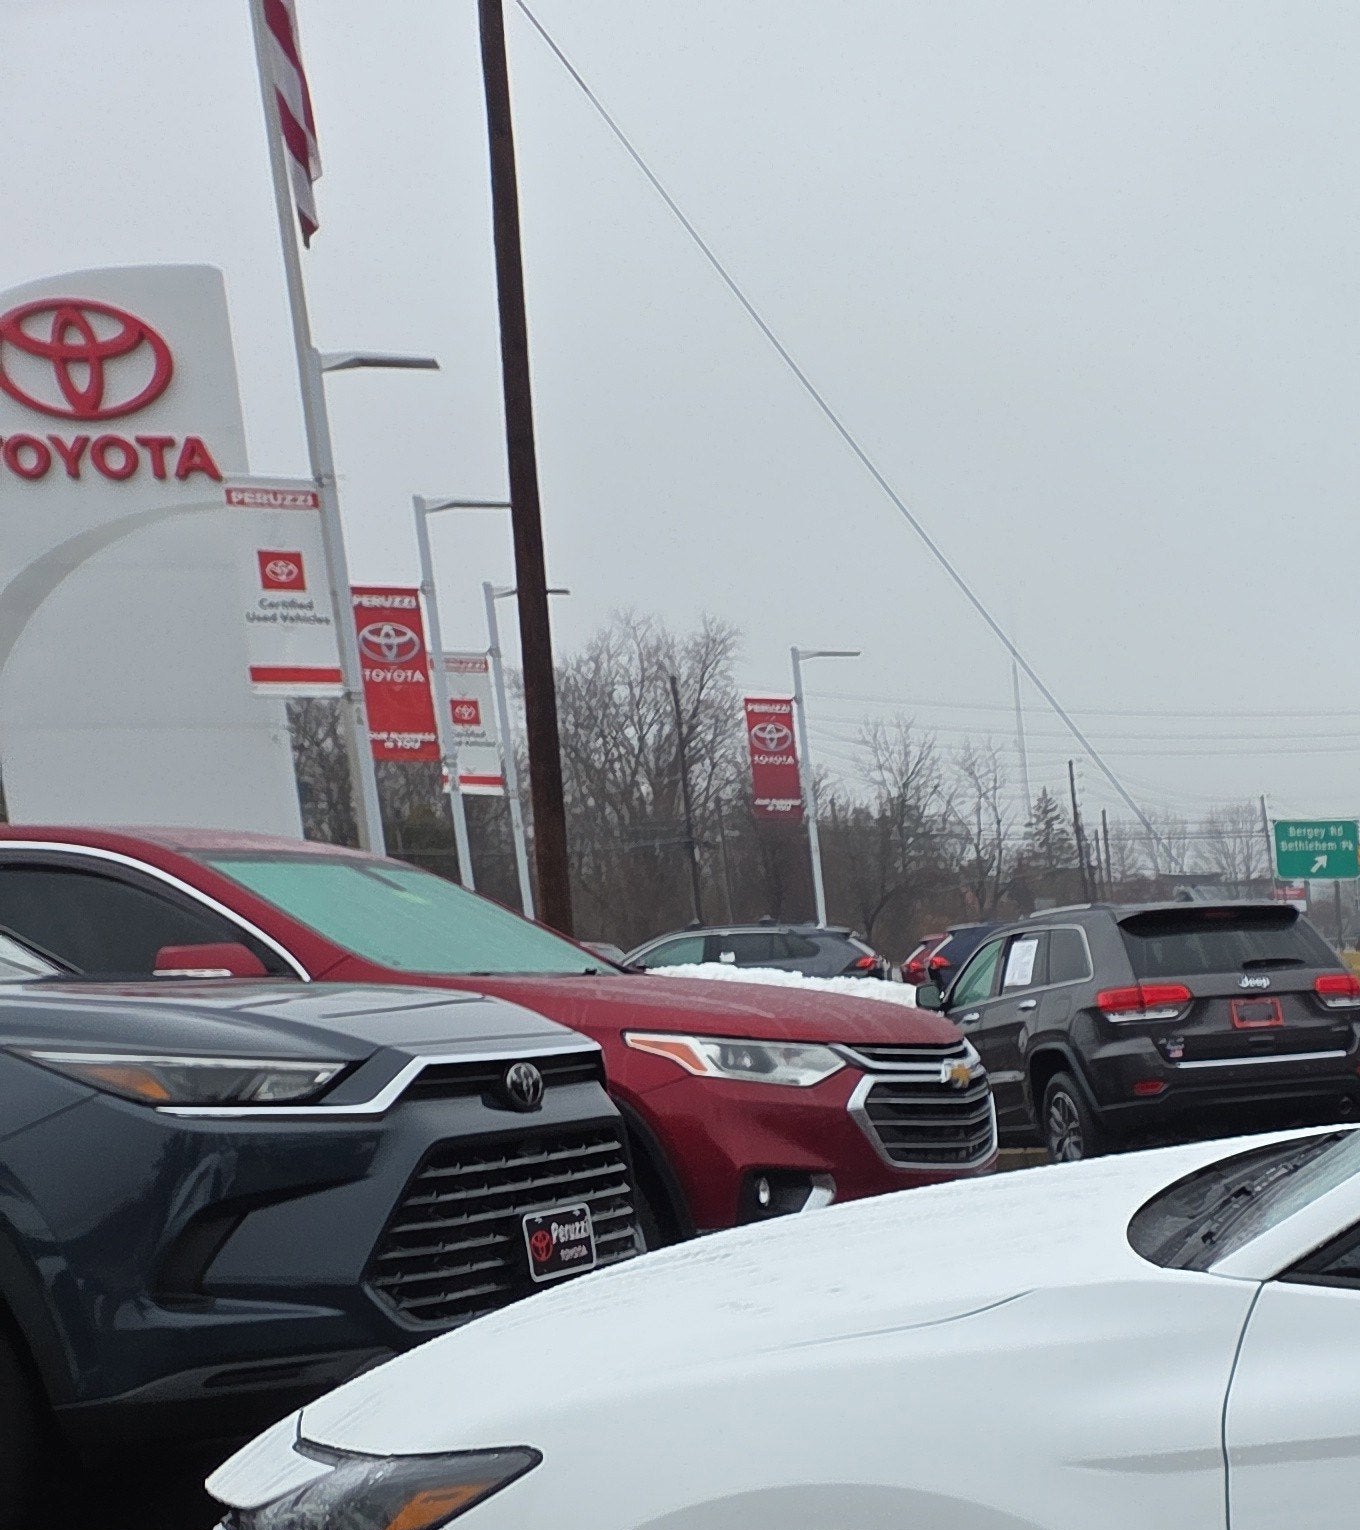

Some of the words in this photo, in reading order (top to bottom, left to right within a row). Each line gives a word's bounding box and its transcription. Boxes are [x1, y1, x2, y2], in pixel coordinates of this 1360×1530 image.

[0, 433, 223, 482] OYOTA
[364, 668, 425, 683] TOYOTA
[1288, 825, 1326, 839] Bergey
[1330, 824, 1344, 837] Rd
[1280, 840, 1337, 852] Bethlehem
[1239, 974, 1271, 989] Jeep
